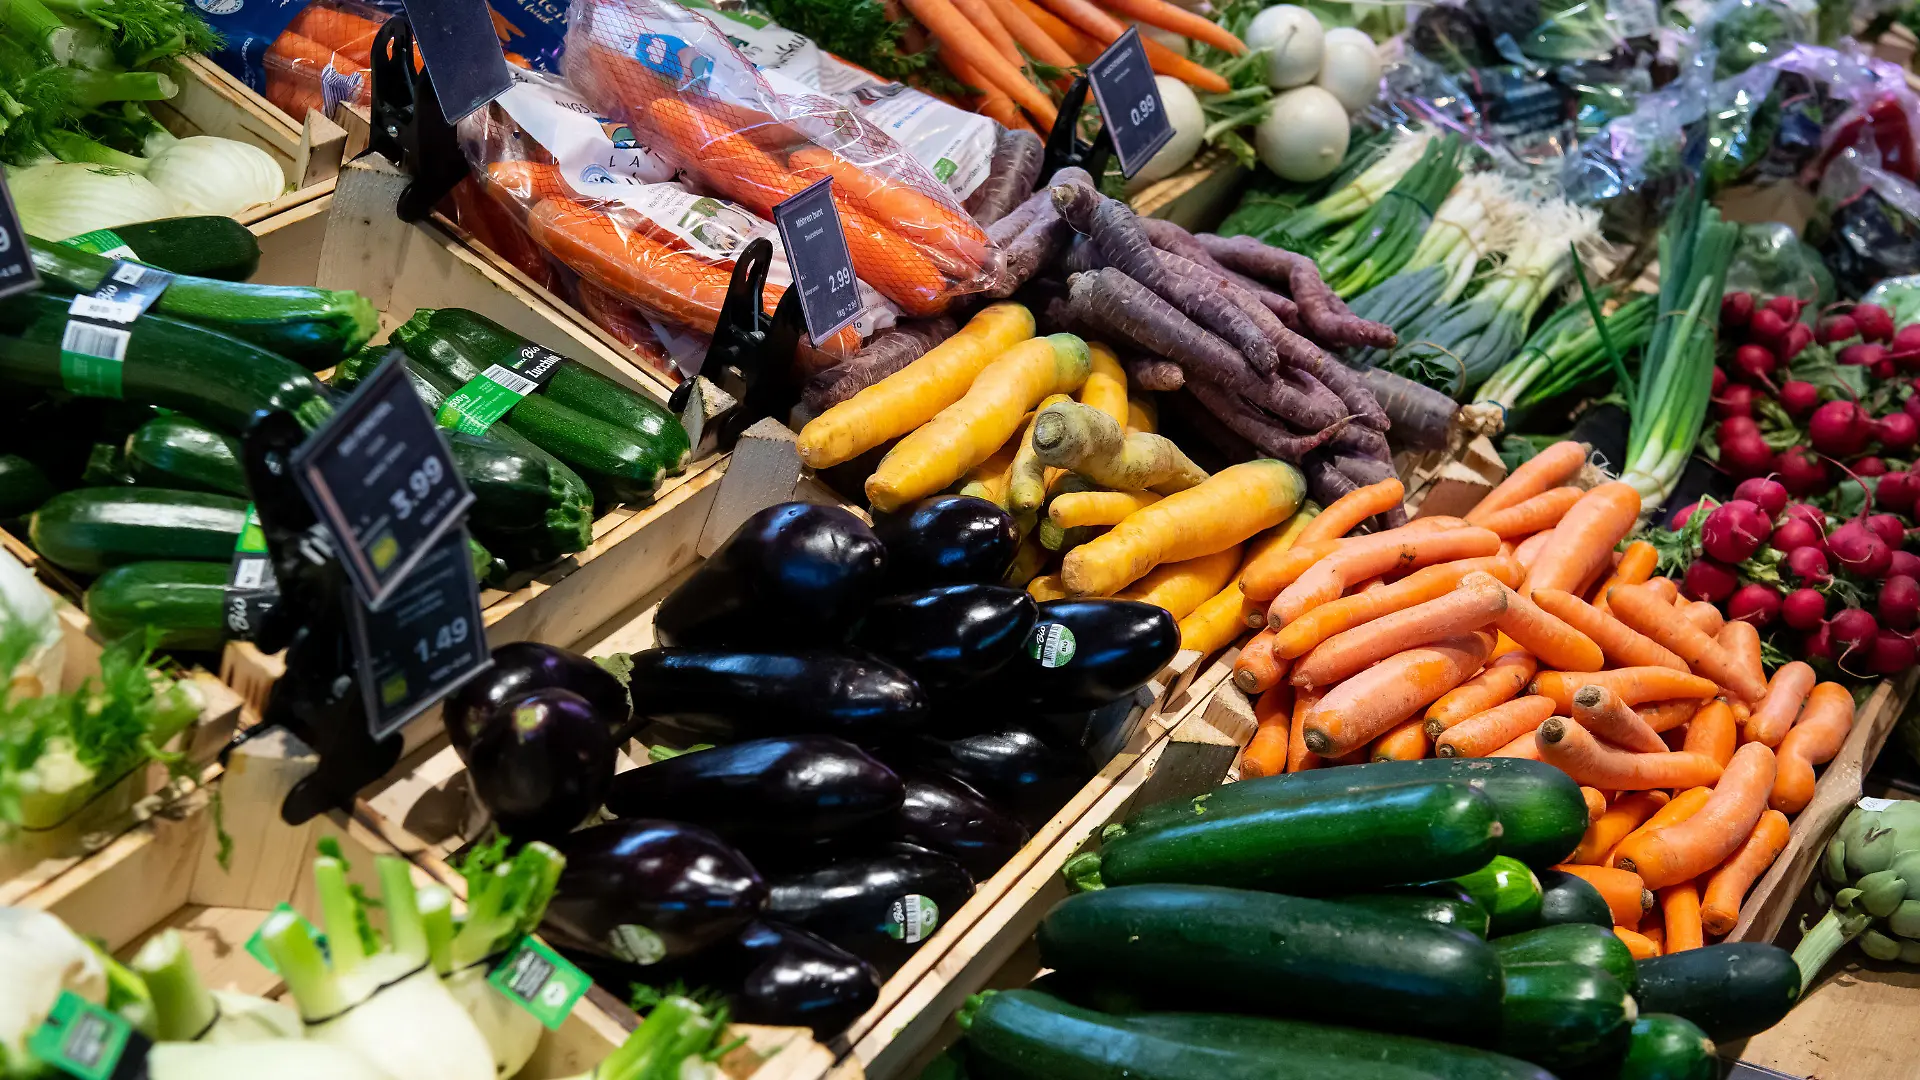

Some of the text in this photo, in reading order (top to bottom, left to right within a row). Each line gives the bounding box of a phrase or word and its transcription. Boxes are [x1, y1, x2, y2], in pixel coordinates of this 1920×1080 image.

[1131, 94, 1156, 127] 0.99
[828, 266, 850, 293] 2.99
[521, 346, 541, 360] Bio
[524, 354, 562, 379] Zucchini
[389, 455, 443, 520] 3.99
[227, 597, 249, 632] Bio
[414, 616, 468, 662] 1.49
[1036, 626, 1046, 644] Bio
[893, 901, 905, 923] Bio
